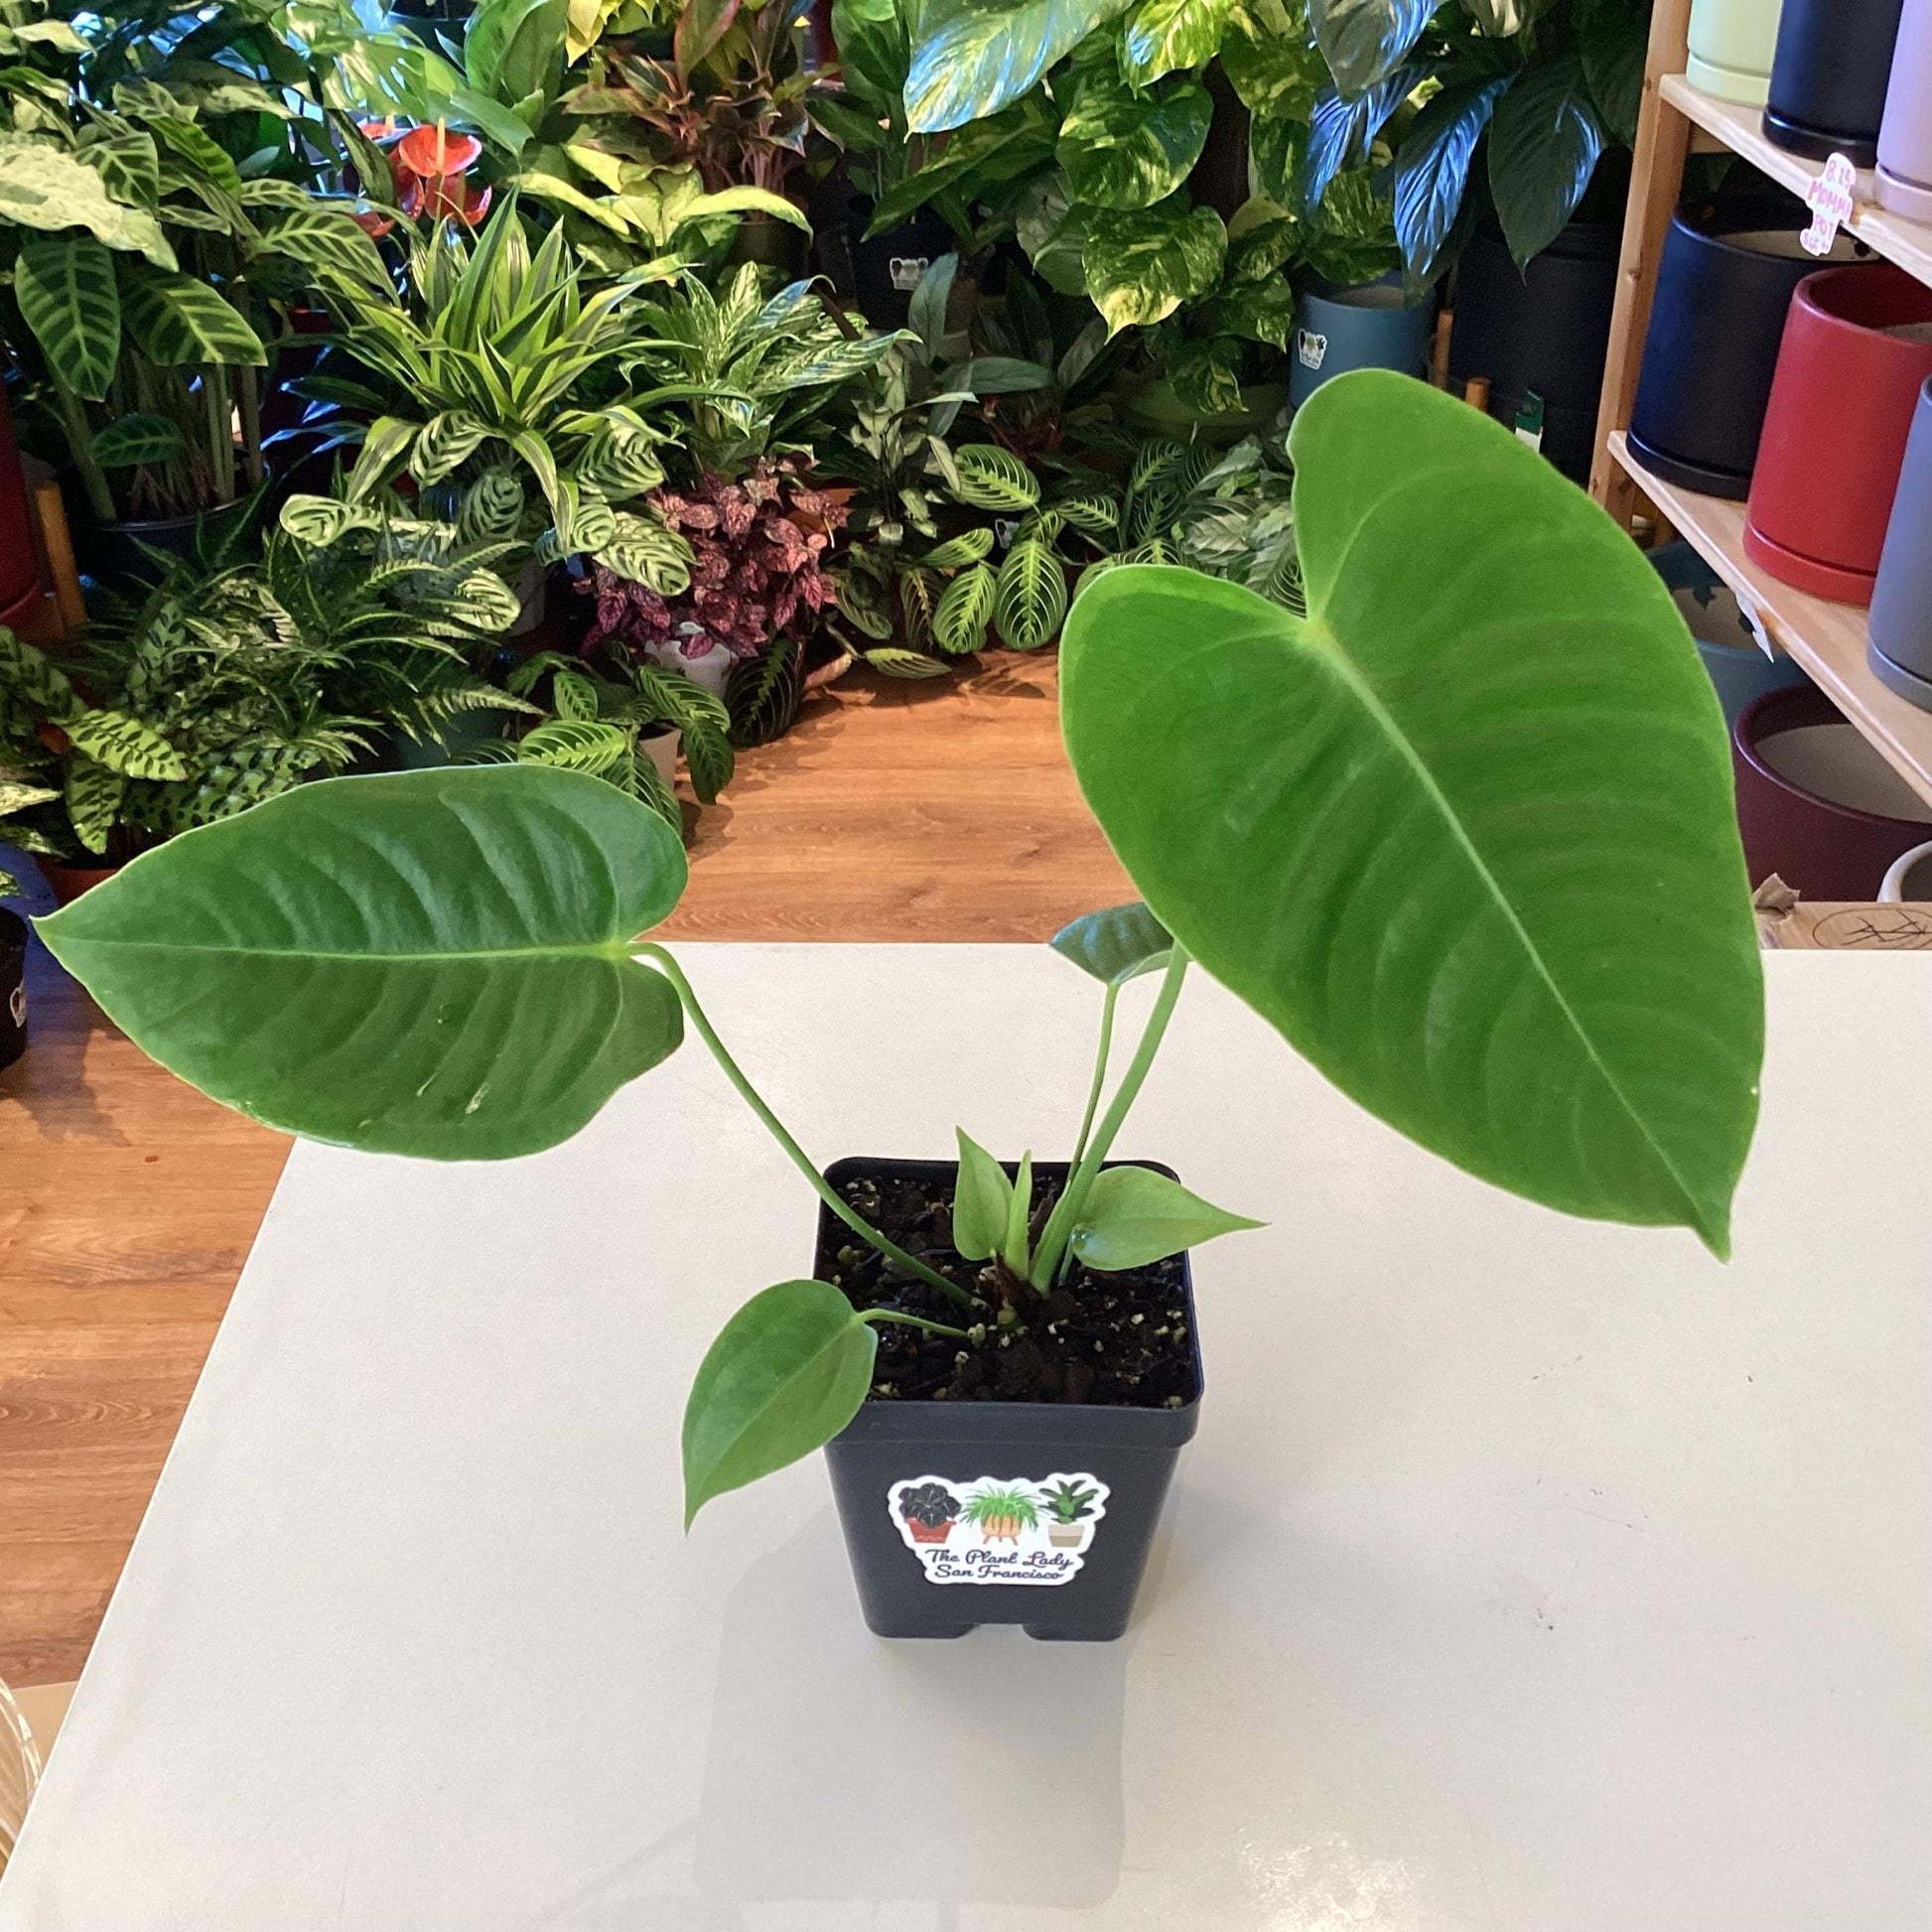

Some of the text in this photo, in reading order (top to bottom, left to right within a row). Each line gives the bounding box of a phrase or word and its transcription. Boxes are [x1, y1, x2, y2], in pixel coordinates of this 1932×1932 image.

[1814, 214, 1835, 240] POT
[925, 1549, 1074, 1571] The Plant Lady
[934, 1564, 1064, 1580] San Francisco
